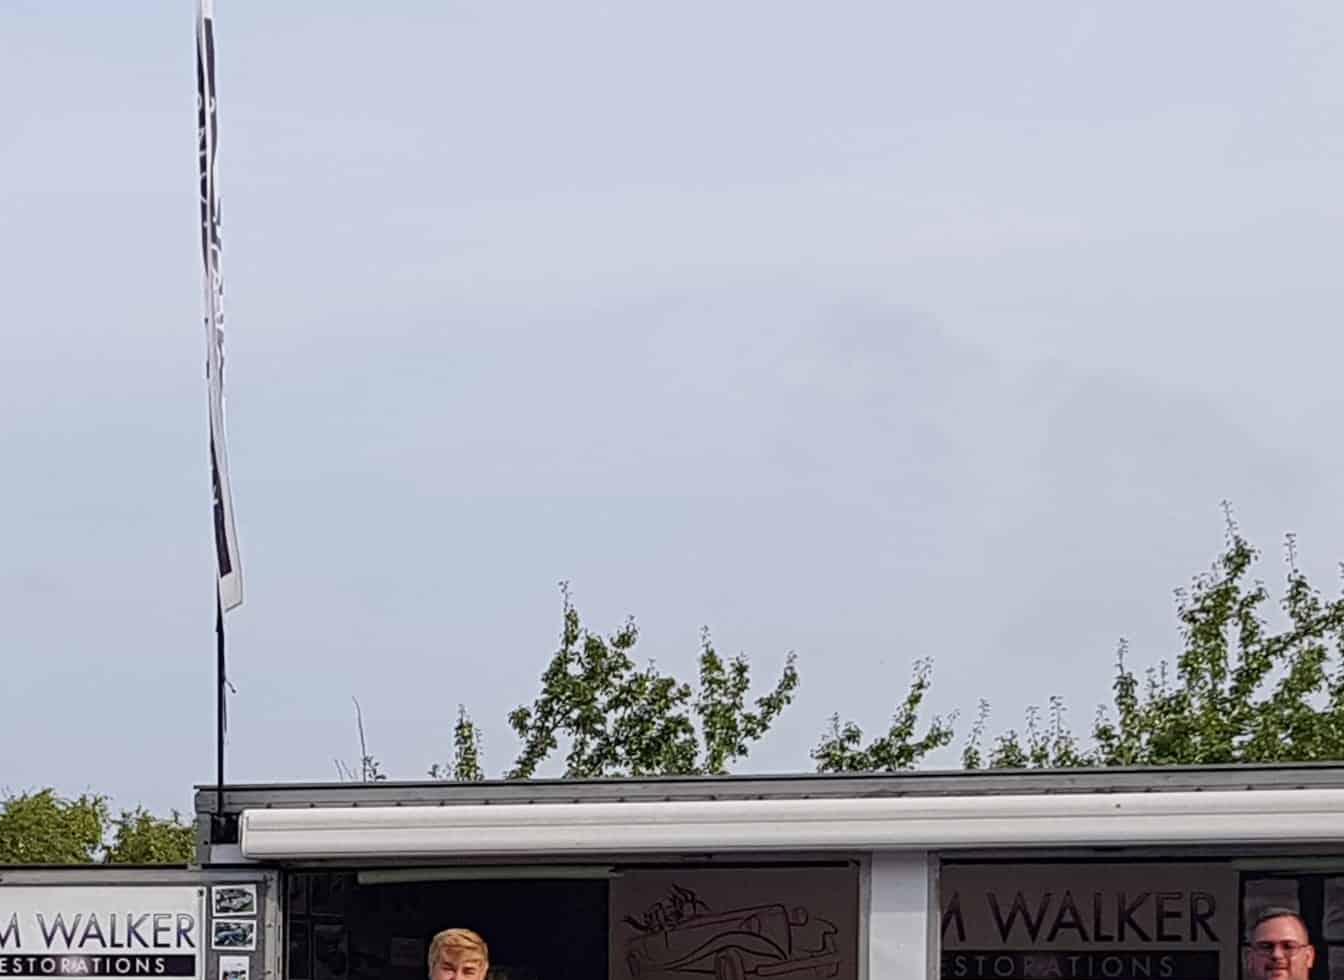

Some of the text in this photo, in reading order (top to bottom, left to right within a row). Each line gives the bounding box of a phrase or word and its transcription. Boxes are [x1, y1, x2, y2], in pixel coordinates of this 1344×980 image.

[36, 912, 196, 949] WALKER
[986, 890, 1221, 943] WALKER
[941, 955, 1175, 977] STORATIONS
